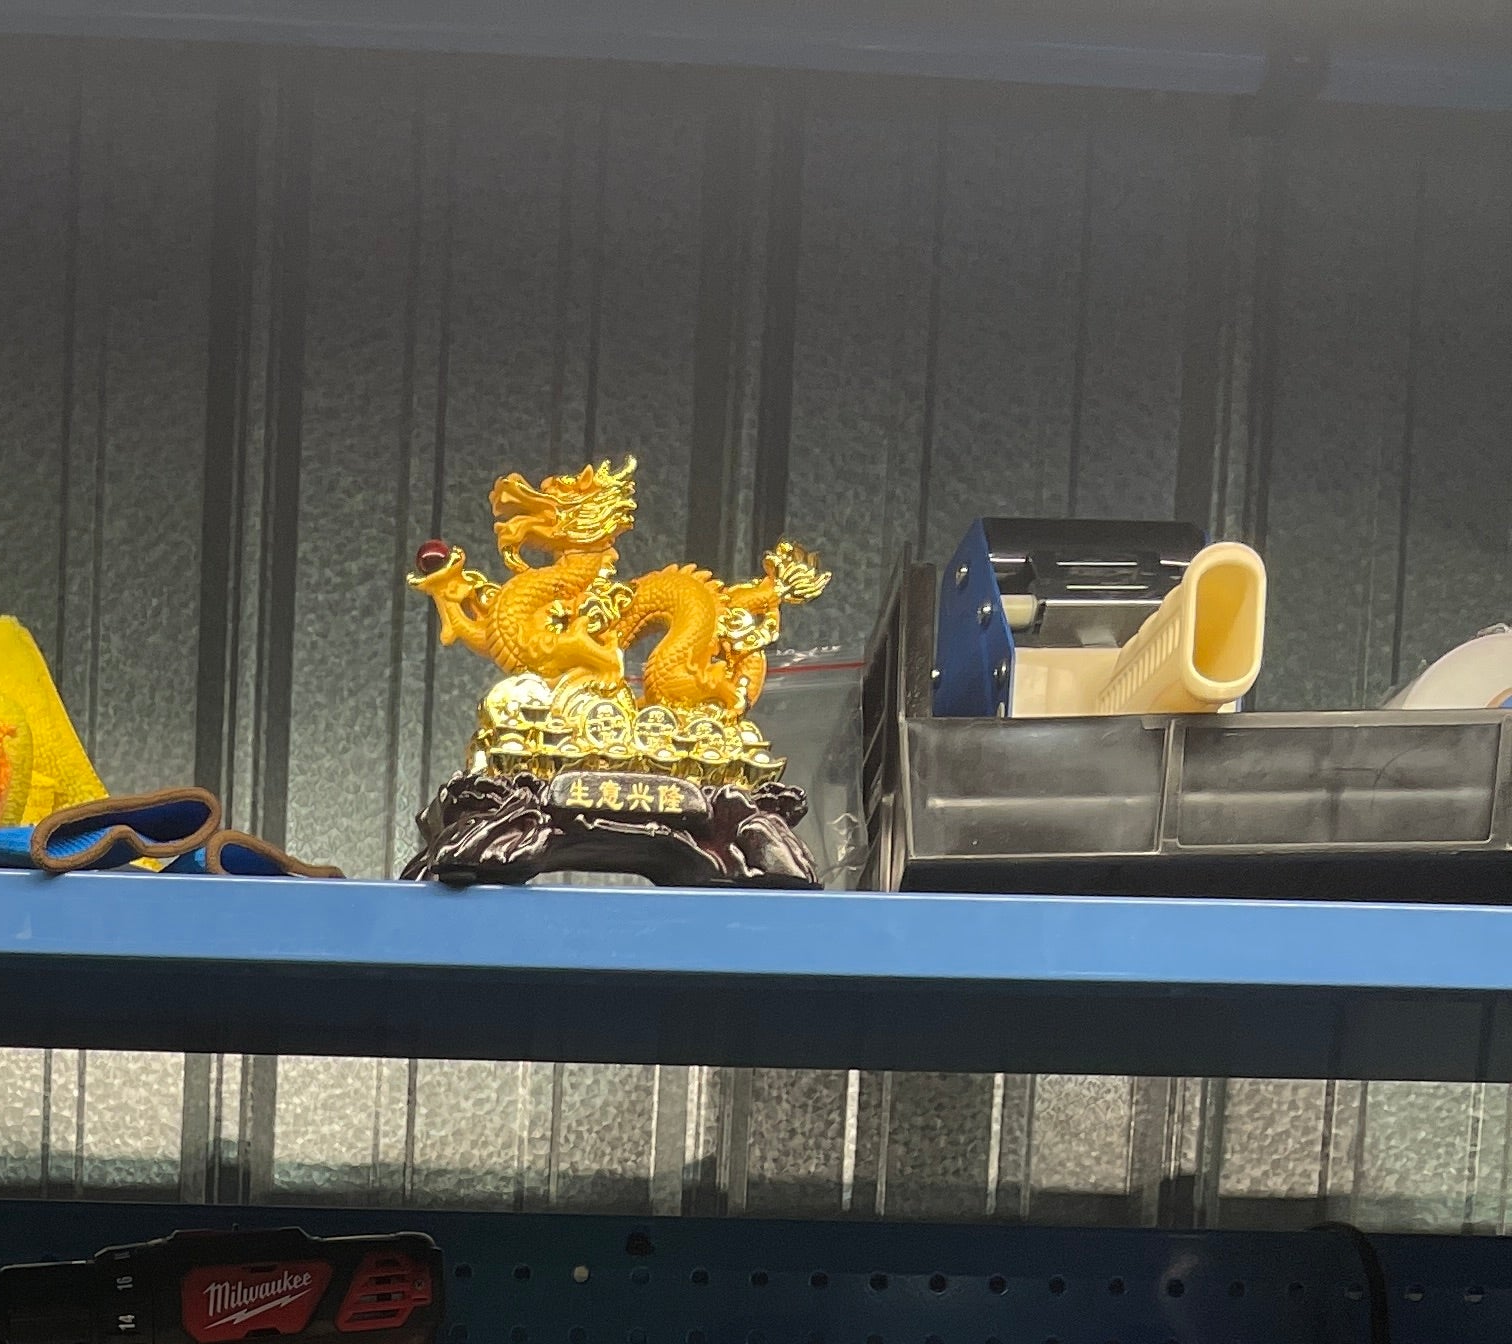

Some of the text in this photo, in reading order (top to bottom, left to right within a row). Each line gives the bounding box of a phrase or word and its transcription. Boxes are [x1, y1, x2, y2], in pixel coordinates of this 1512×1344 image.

[565, 778, 685, 813] 生意兴隆
[116, 1275, 134, 1291] 16
[202, 1270, 313, 1317] Milwaukee
[118, 1314, 136, 1331] 14
